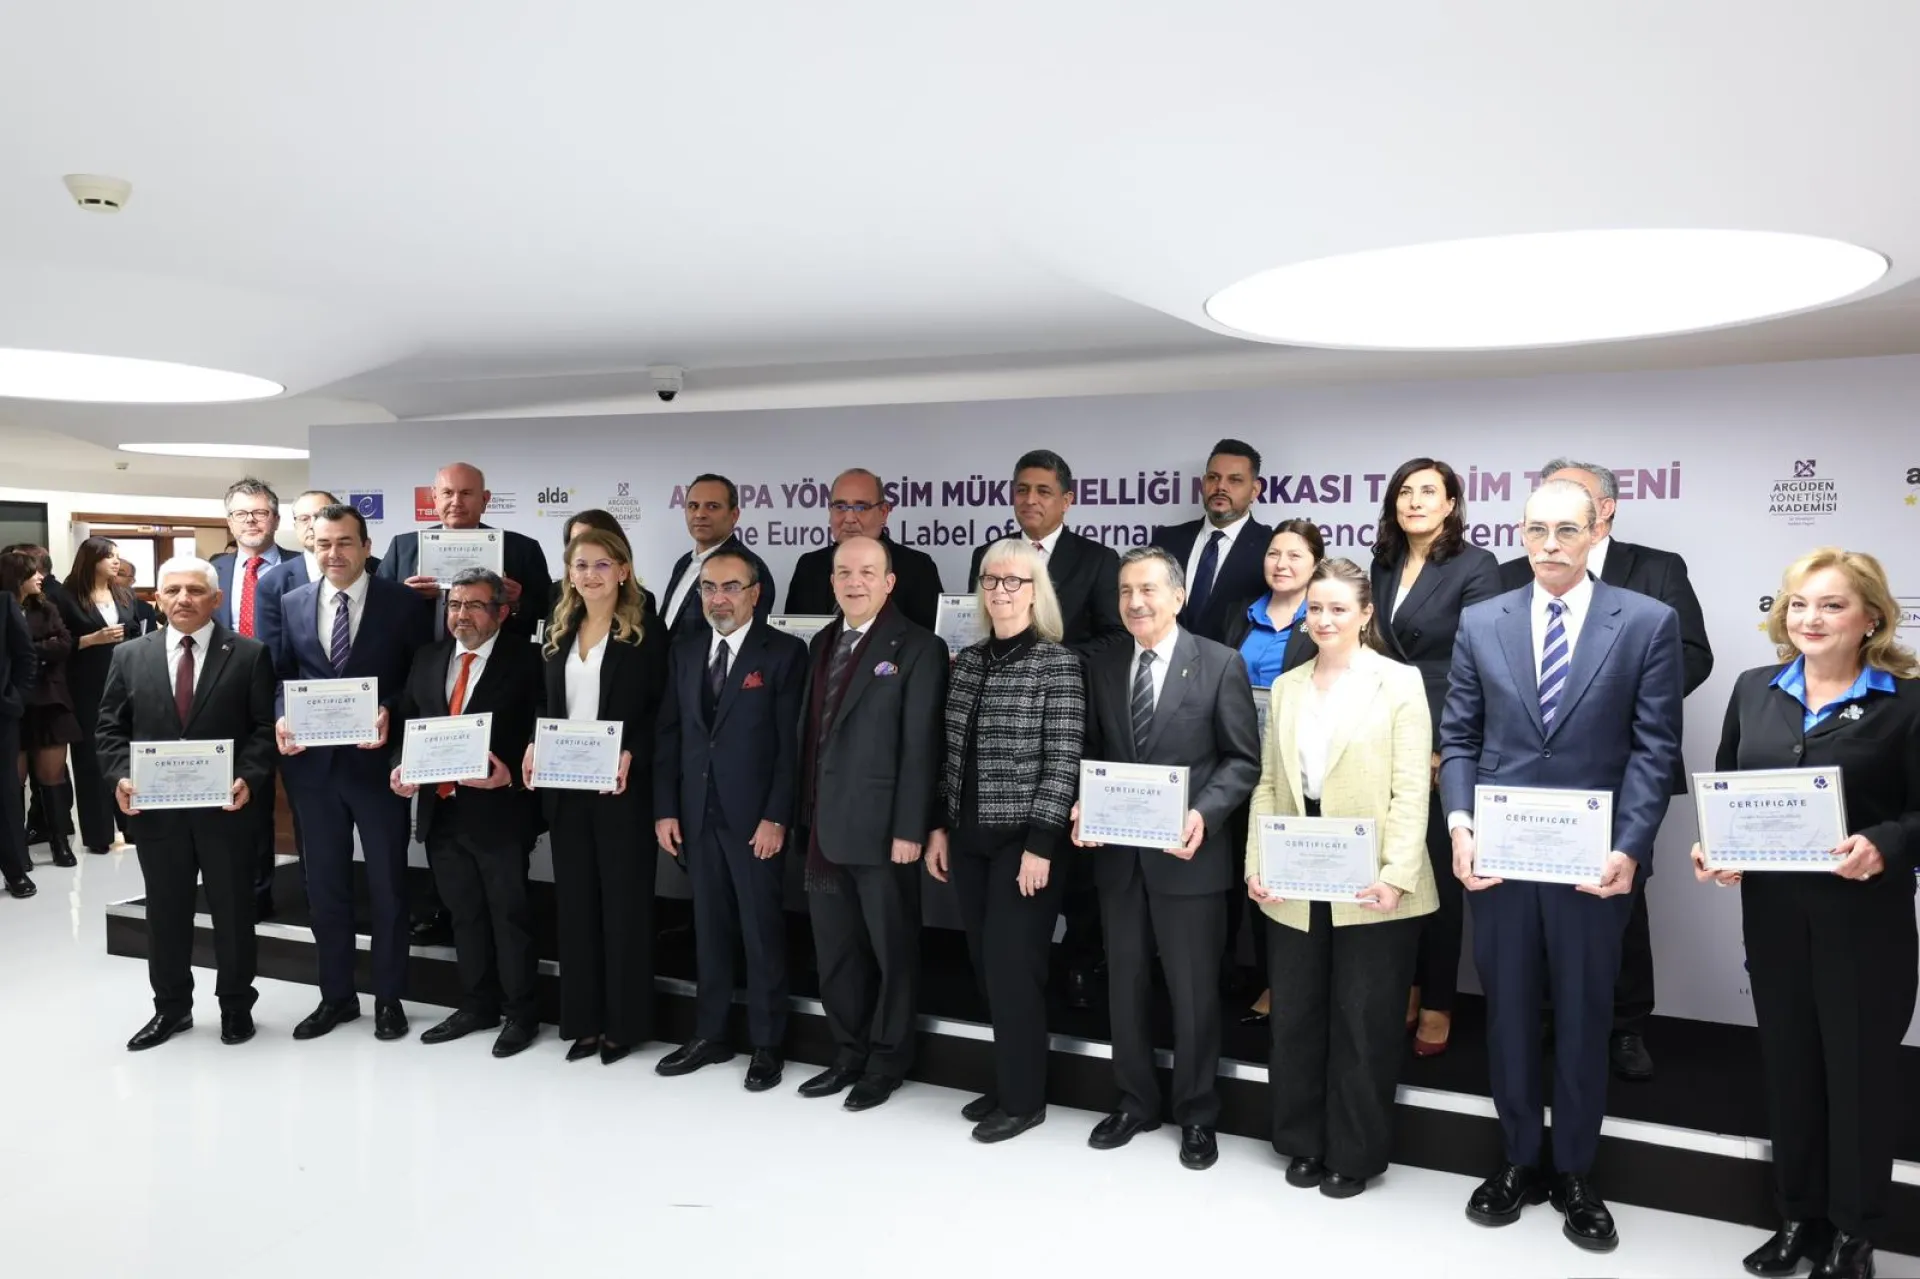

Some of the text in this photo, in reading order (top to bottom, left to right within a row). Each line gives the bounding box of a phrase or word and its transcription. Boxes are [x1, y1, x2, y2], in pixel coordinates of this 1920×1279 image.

[669, 461, 1680, 512] APA YÖNŞİM MÜKELLİĞİ RKASI TİM TENİ
[1773, 481, 1834, 492] ARGÜDEN
[538, 486, 569, 504] alda
[1769, 491, 1837, 502] YÖNETİŞİM
[1769, 502, 1837, 513] AKADEMİSİ
[901, 519, 974, 546] Label
[1104, 786, 1161, 796] CERTIFICATE
[1729, 799, 1808, 809] CERTIFICATE
[1505, 814, 1579, 825] CERTIFICATE
[1285, 840, 1348, 849] CERTIFICATE
